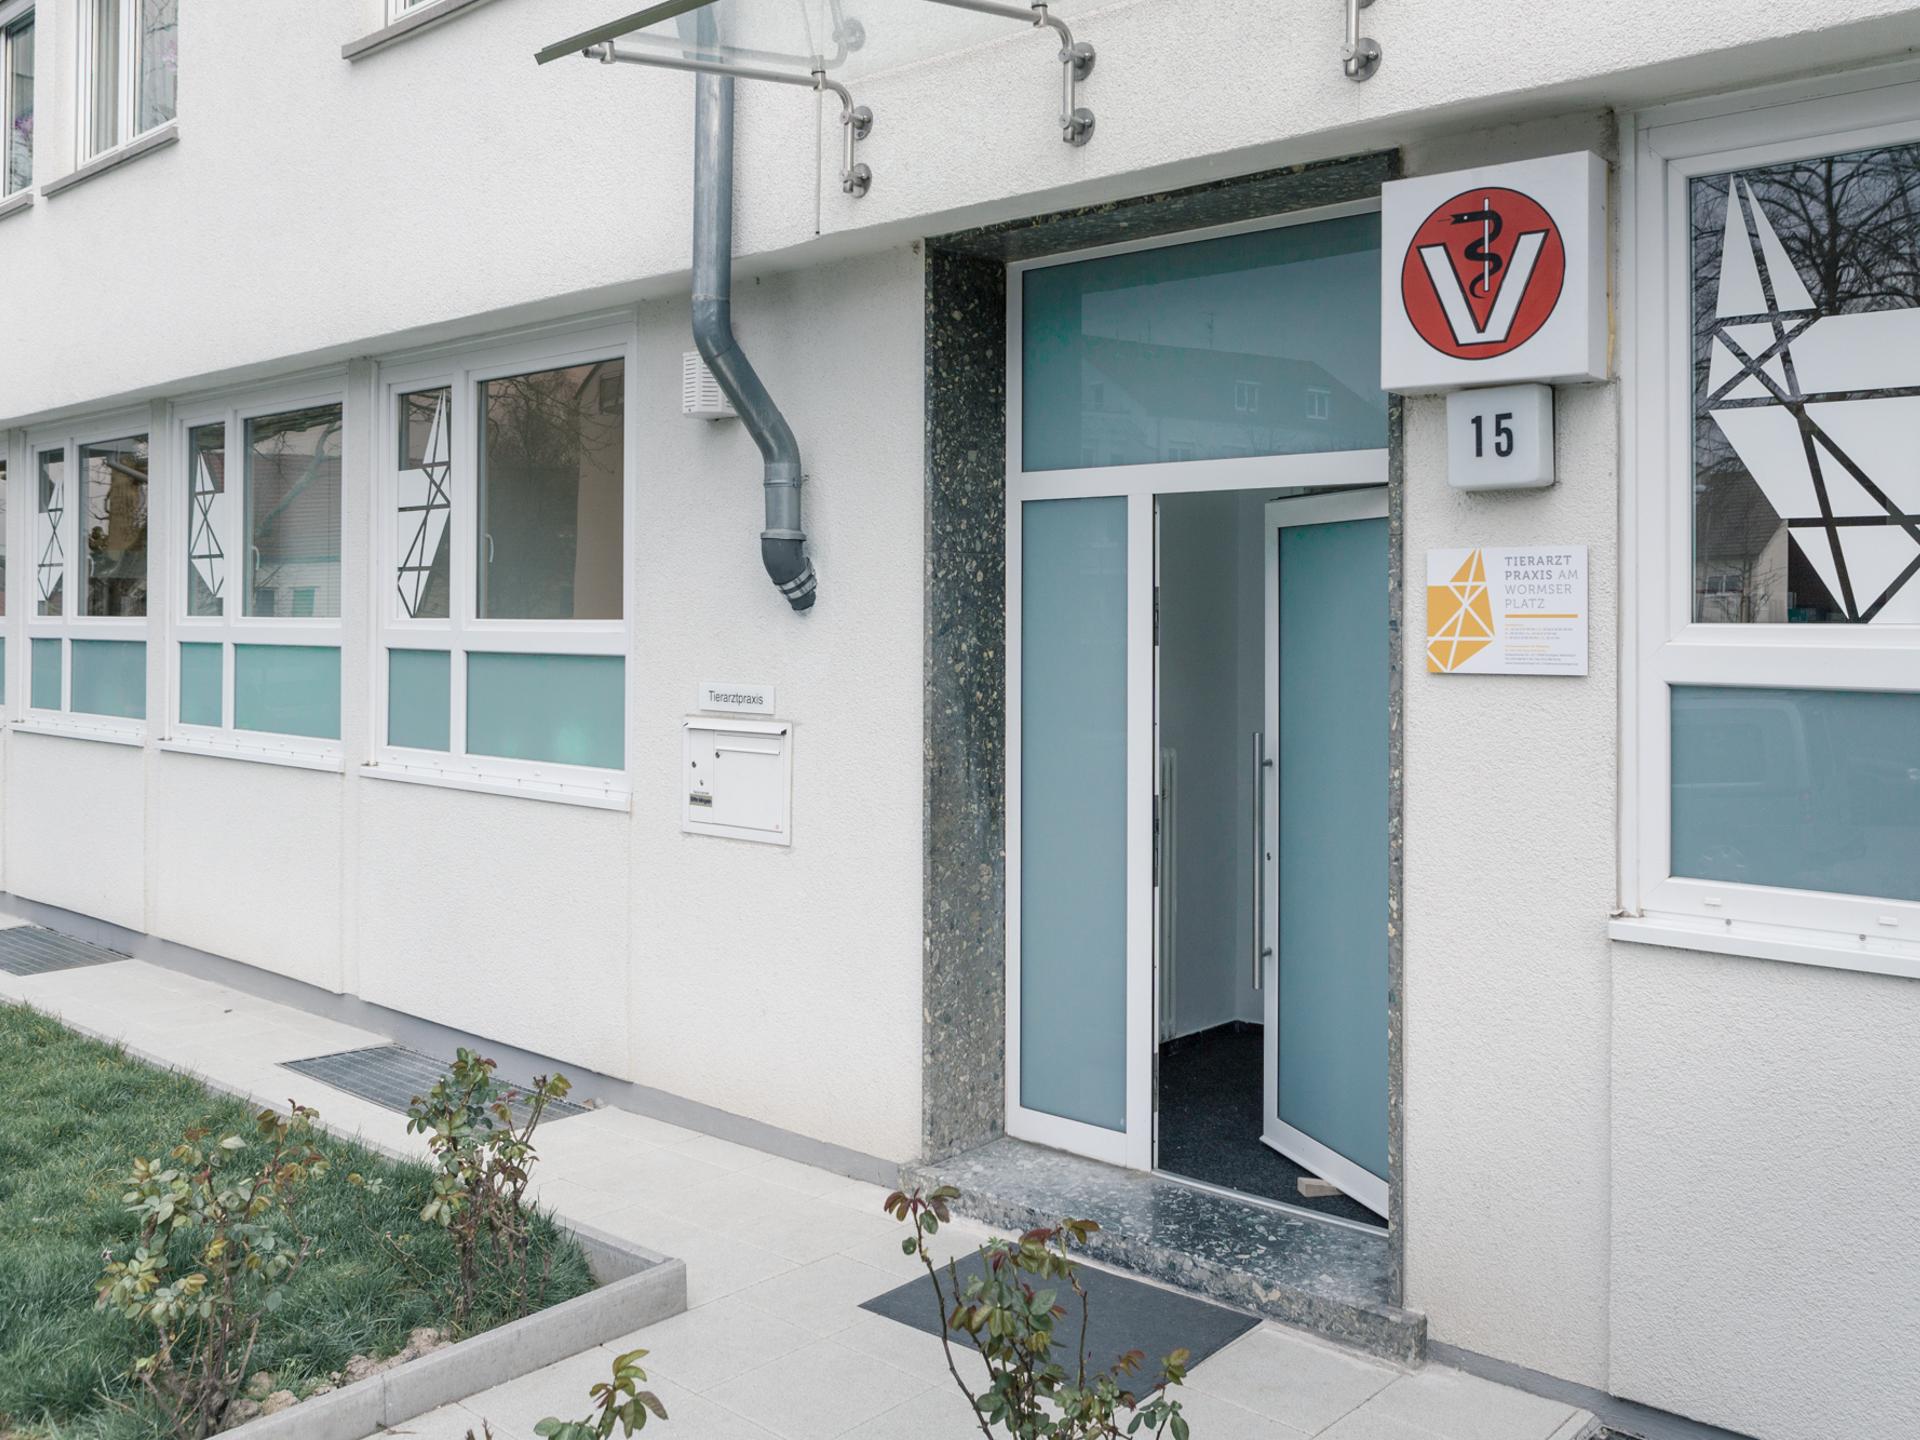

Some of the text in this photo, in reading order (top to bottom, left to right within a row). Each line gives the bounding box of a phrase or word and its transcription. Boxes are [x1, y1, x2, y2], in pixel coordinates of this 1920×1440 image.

[1416, 229, 1550, 347] V
[1470, 412, 1514, 458] 15
[1504, 555, 1572, 567] TIERARZT
[1504, 569, 1579, 581] PRAXIS AM
[1504, 584, 1573, 595] WORMSER
[1504, 598, 1545, 609] PLATZ
[708, 690, 764, 706] Tierarztpraxis
